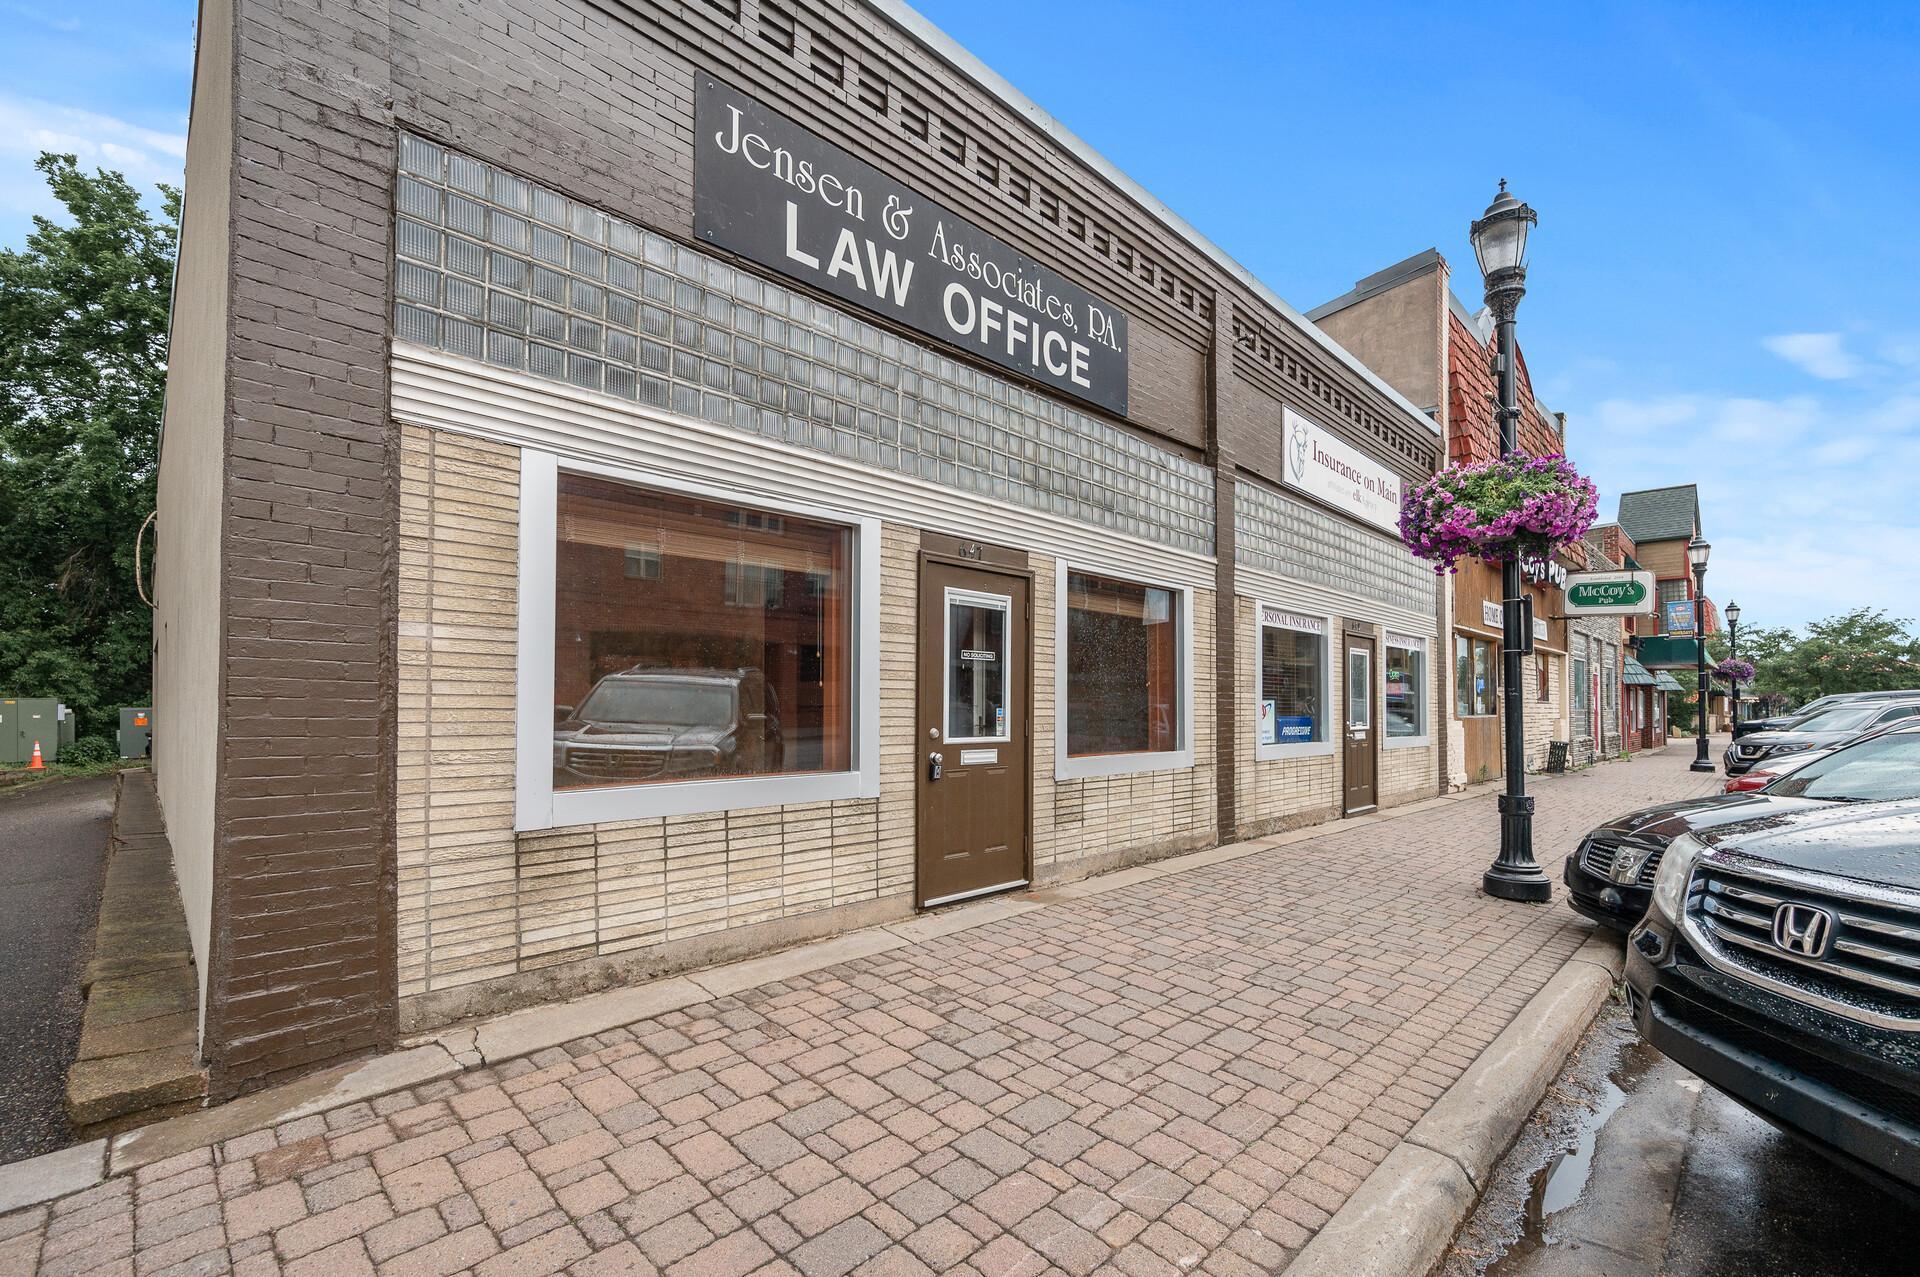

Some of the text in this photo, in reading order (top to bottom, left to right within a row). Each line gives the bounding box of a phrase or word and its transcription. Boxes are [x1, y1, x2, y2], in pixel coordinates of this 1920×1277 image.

[715, 103, 865, 222] Jensen
[882, 195, 914, 240] &
[928, 221, 1078, 333] Associates,
[785, 200, 1091, 389] LAW OFFICE
[1312, 439, 1361, 484] Insurance
[1363, 475, 1375, 493] on
[1377, 477, 1397, 504] Main
[1548, 560, 1567, 591] PUB
[1578, 583, 1635, 598] McCoy's
[1262, 610, 1320, 631] ERSONAL INSURANCE
